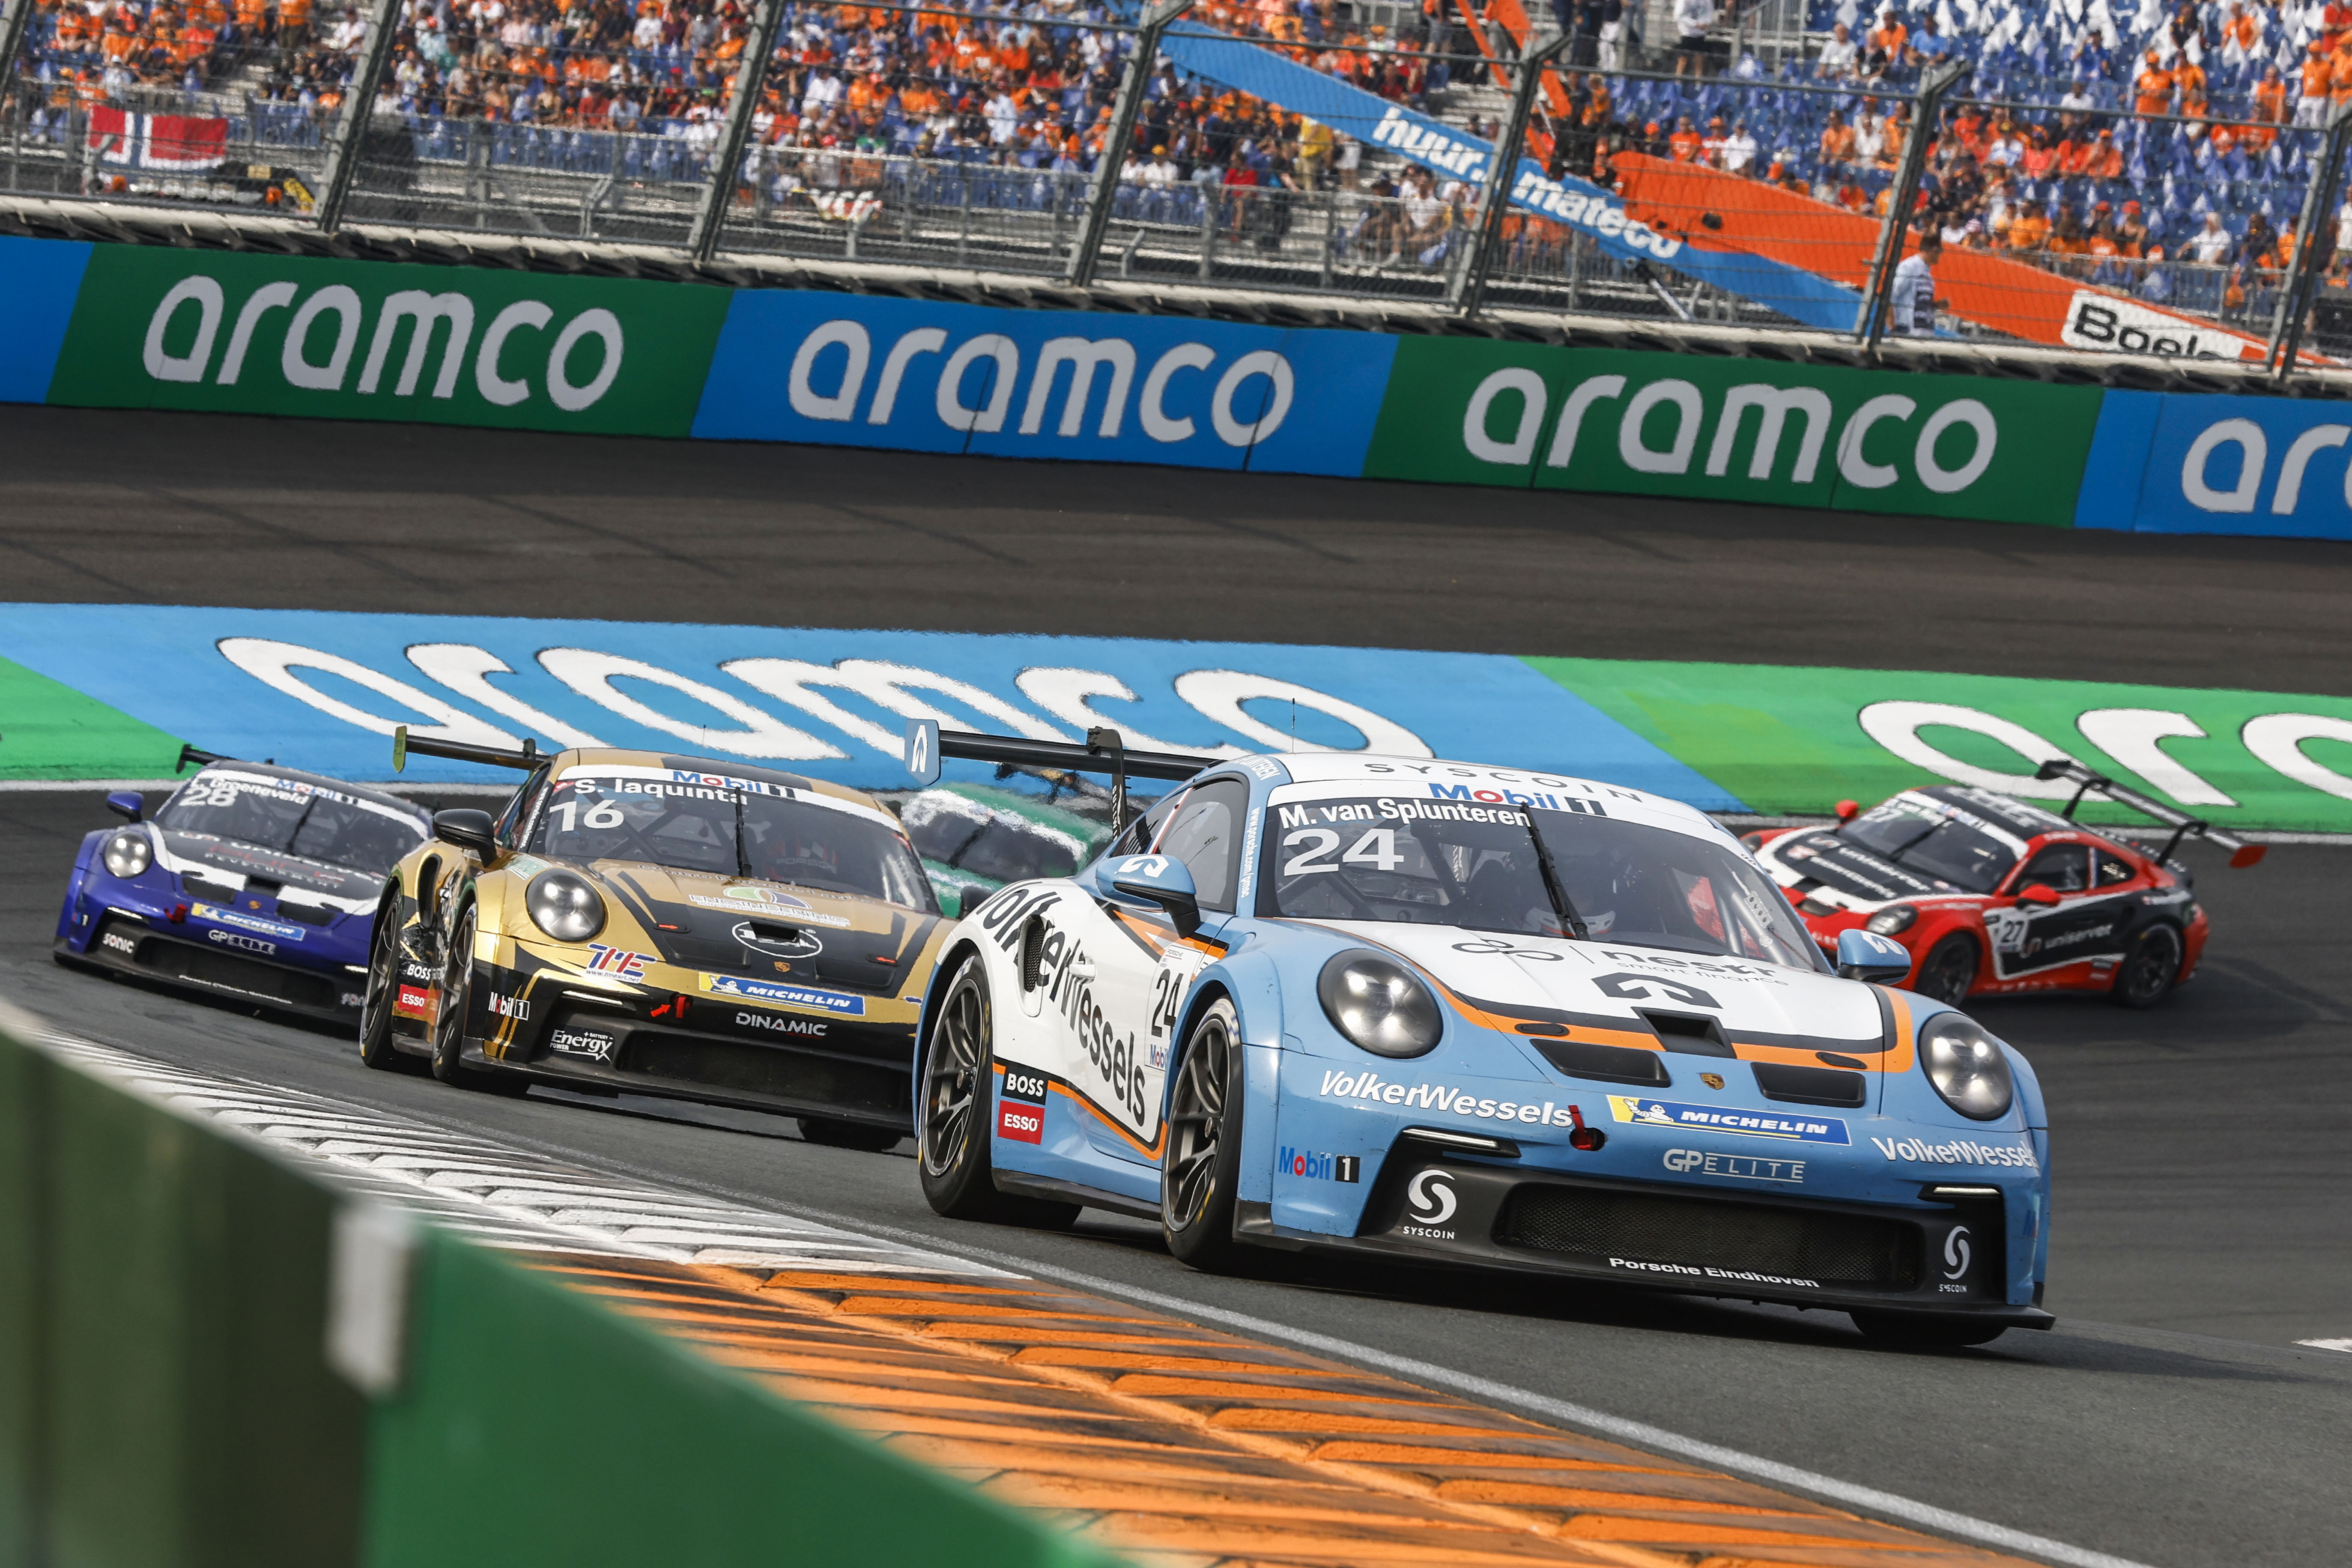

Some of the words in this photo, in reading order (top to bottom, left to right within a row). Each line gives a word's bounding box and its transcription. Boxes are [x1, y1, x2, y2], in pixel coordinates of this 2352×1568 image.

[143, 275, 624, 412] aramco
[2074, 303, 2221, 359] Boel
[788, 320, 1294, 447] aramco
[1463, 367, 1997, 494] aramco
[2181, 417, 2352, 515] ar
[209, 777, 310, 805] Groeneveld
[574, 779, 606, 794] S.
[672, 770, 762, 794] Mobil
[1364, 762, 1644, 804] SYSCOIN
[179, 786, 240, 807] 28
[1428, 783, 1561, 811] Mobil
[549, 799, 625, 832] 16
[1278, 806, 1318, 830] M.
[1319, 802, 1375, 825] van
[1379, 797, 1533, 828] Splunteren
[1283, 827, 1405, 877] 24
[223, 914, 296, 935] MICHELIN
[2001, 920, 2025, 943] 27
[407, 963, 431, 981] BOSS
[1600, 949, 1778, 979] nestr
[1617, 961, 1691, 977] smart
[1694, 968, 1789, 987] finance
[402, 993, 425, 1007] ESSO
[488, 991, 514, 1017] Mobil
[746, 984, 851, 1008] MICHELIN
[1151, 968, 1184, 1040] 24
[735, 1012, 829, 1036] DINAMIC
[549, 1042, 570, 1051] POWER
[551, 1029, 613, 1054] Energy
[1006, 1072, 1045, 1096] BOSS
[1319, 1069, 1573, 1128] VolkerWessels
[1003, 1113, 1040, 1132] ESSO
[1679, 1110, 1829, 1135] MICHELIN
[1278, 1146, 1331, 1181] Mobil
[1403, 1225, 1455, 1241] SYSCOIN
[1609, 1257, 1701, 1277] Porsche
[1703, 1266, 1821, 1289] Eindhoven
